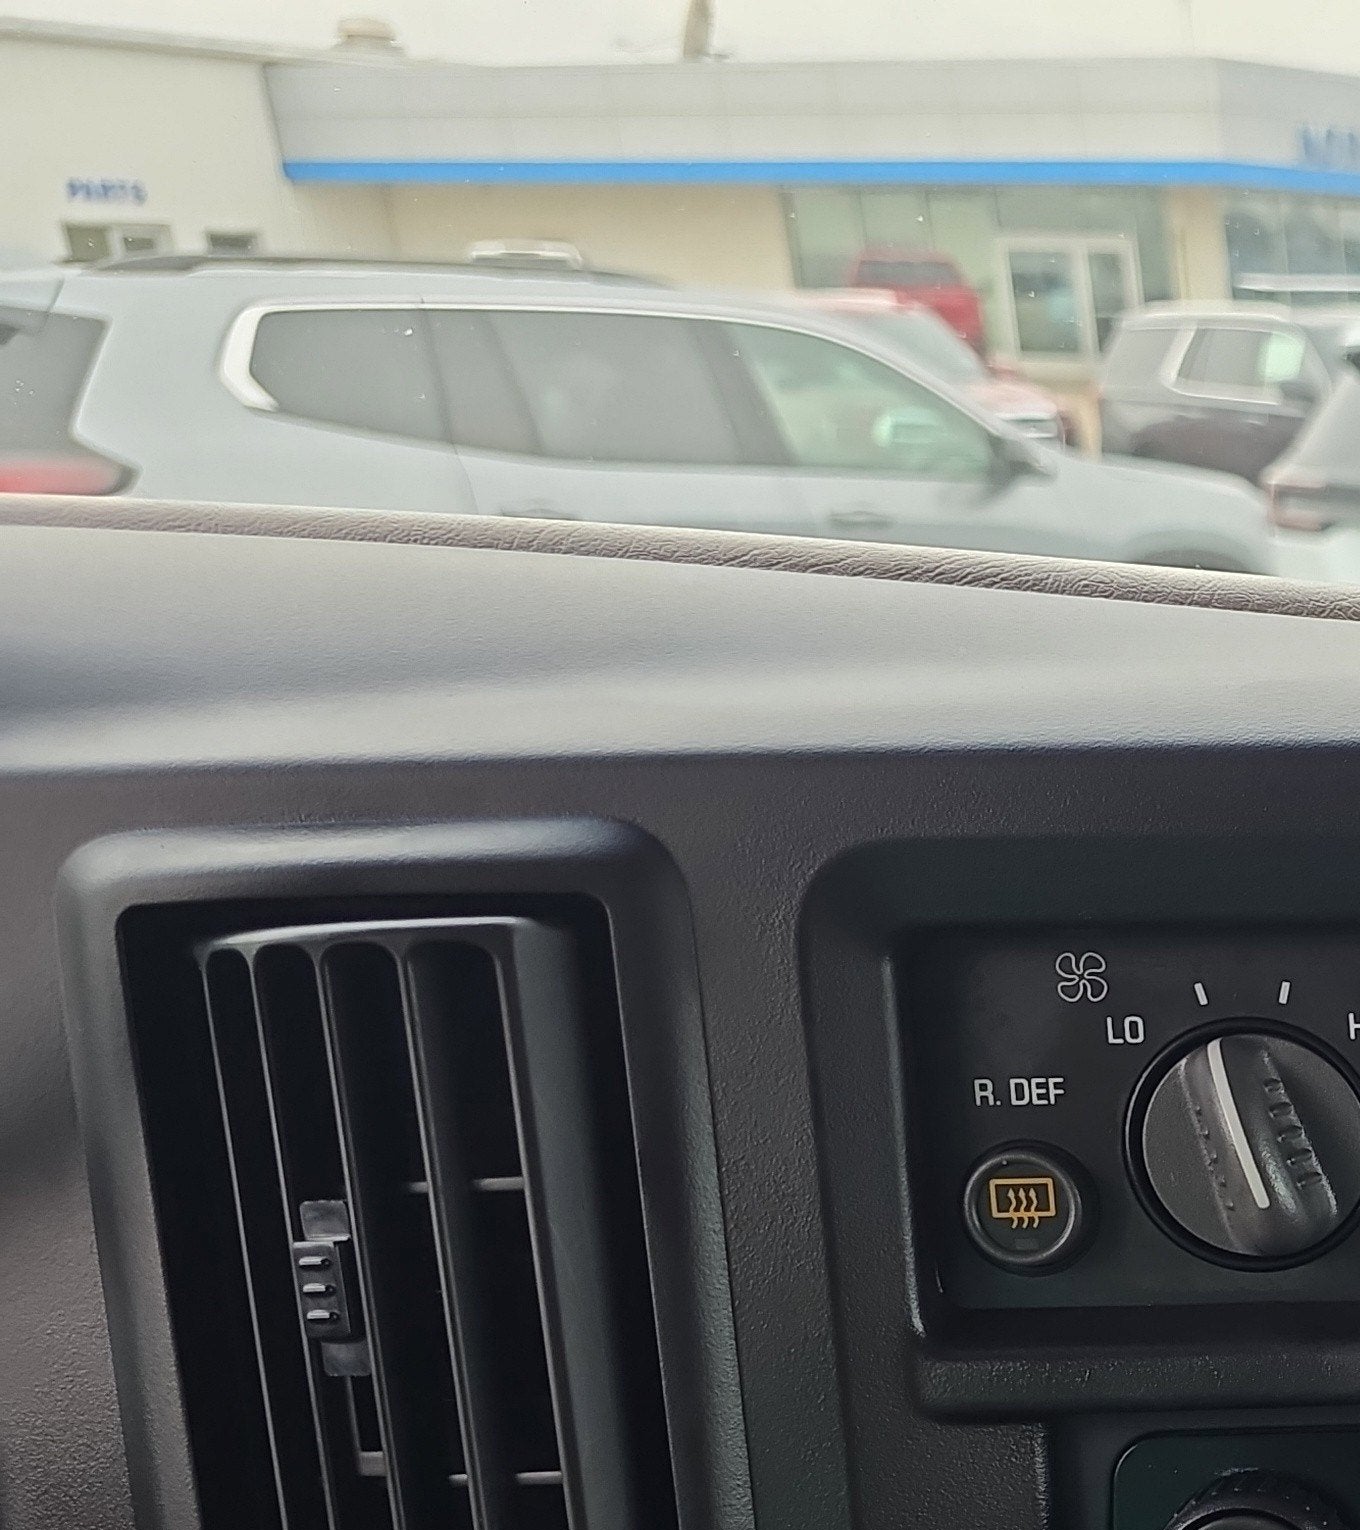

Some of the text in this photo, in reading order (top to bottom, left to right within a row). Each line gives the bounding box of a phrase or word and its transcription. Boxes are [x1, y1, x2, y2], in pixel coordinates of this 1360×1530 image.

[1106, 1015, 1145, 1044] LO
[974, 1077, 1065, 1107] R. DEF
